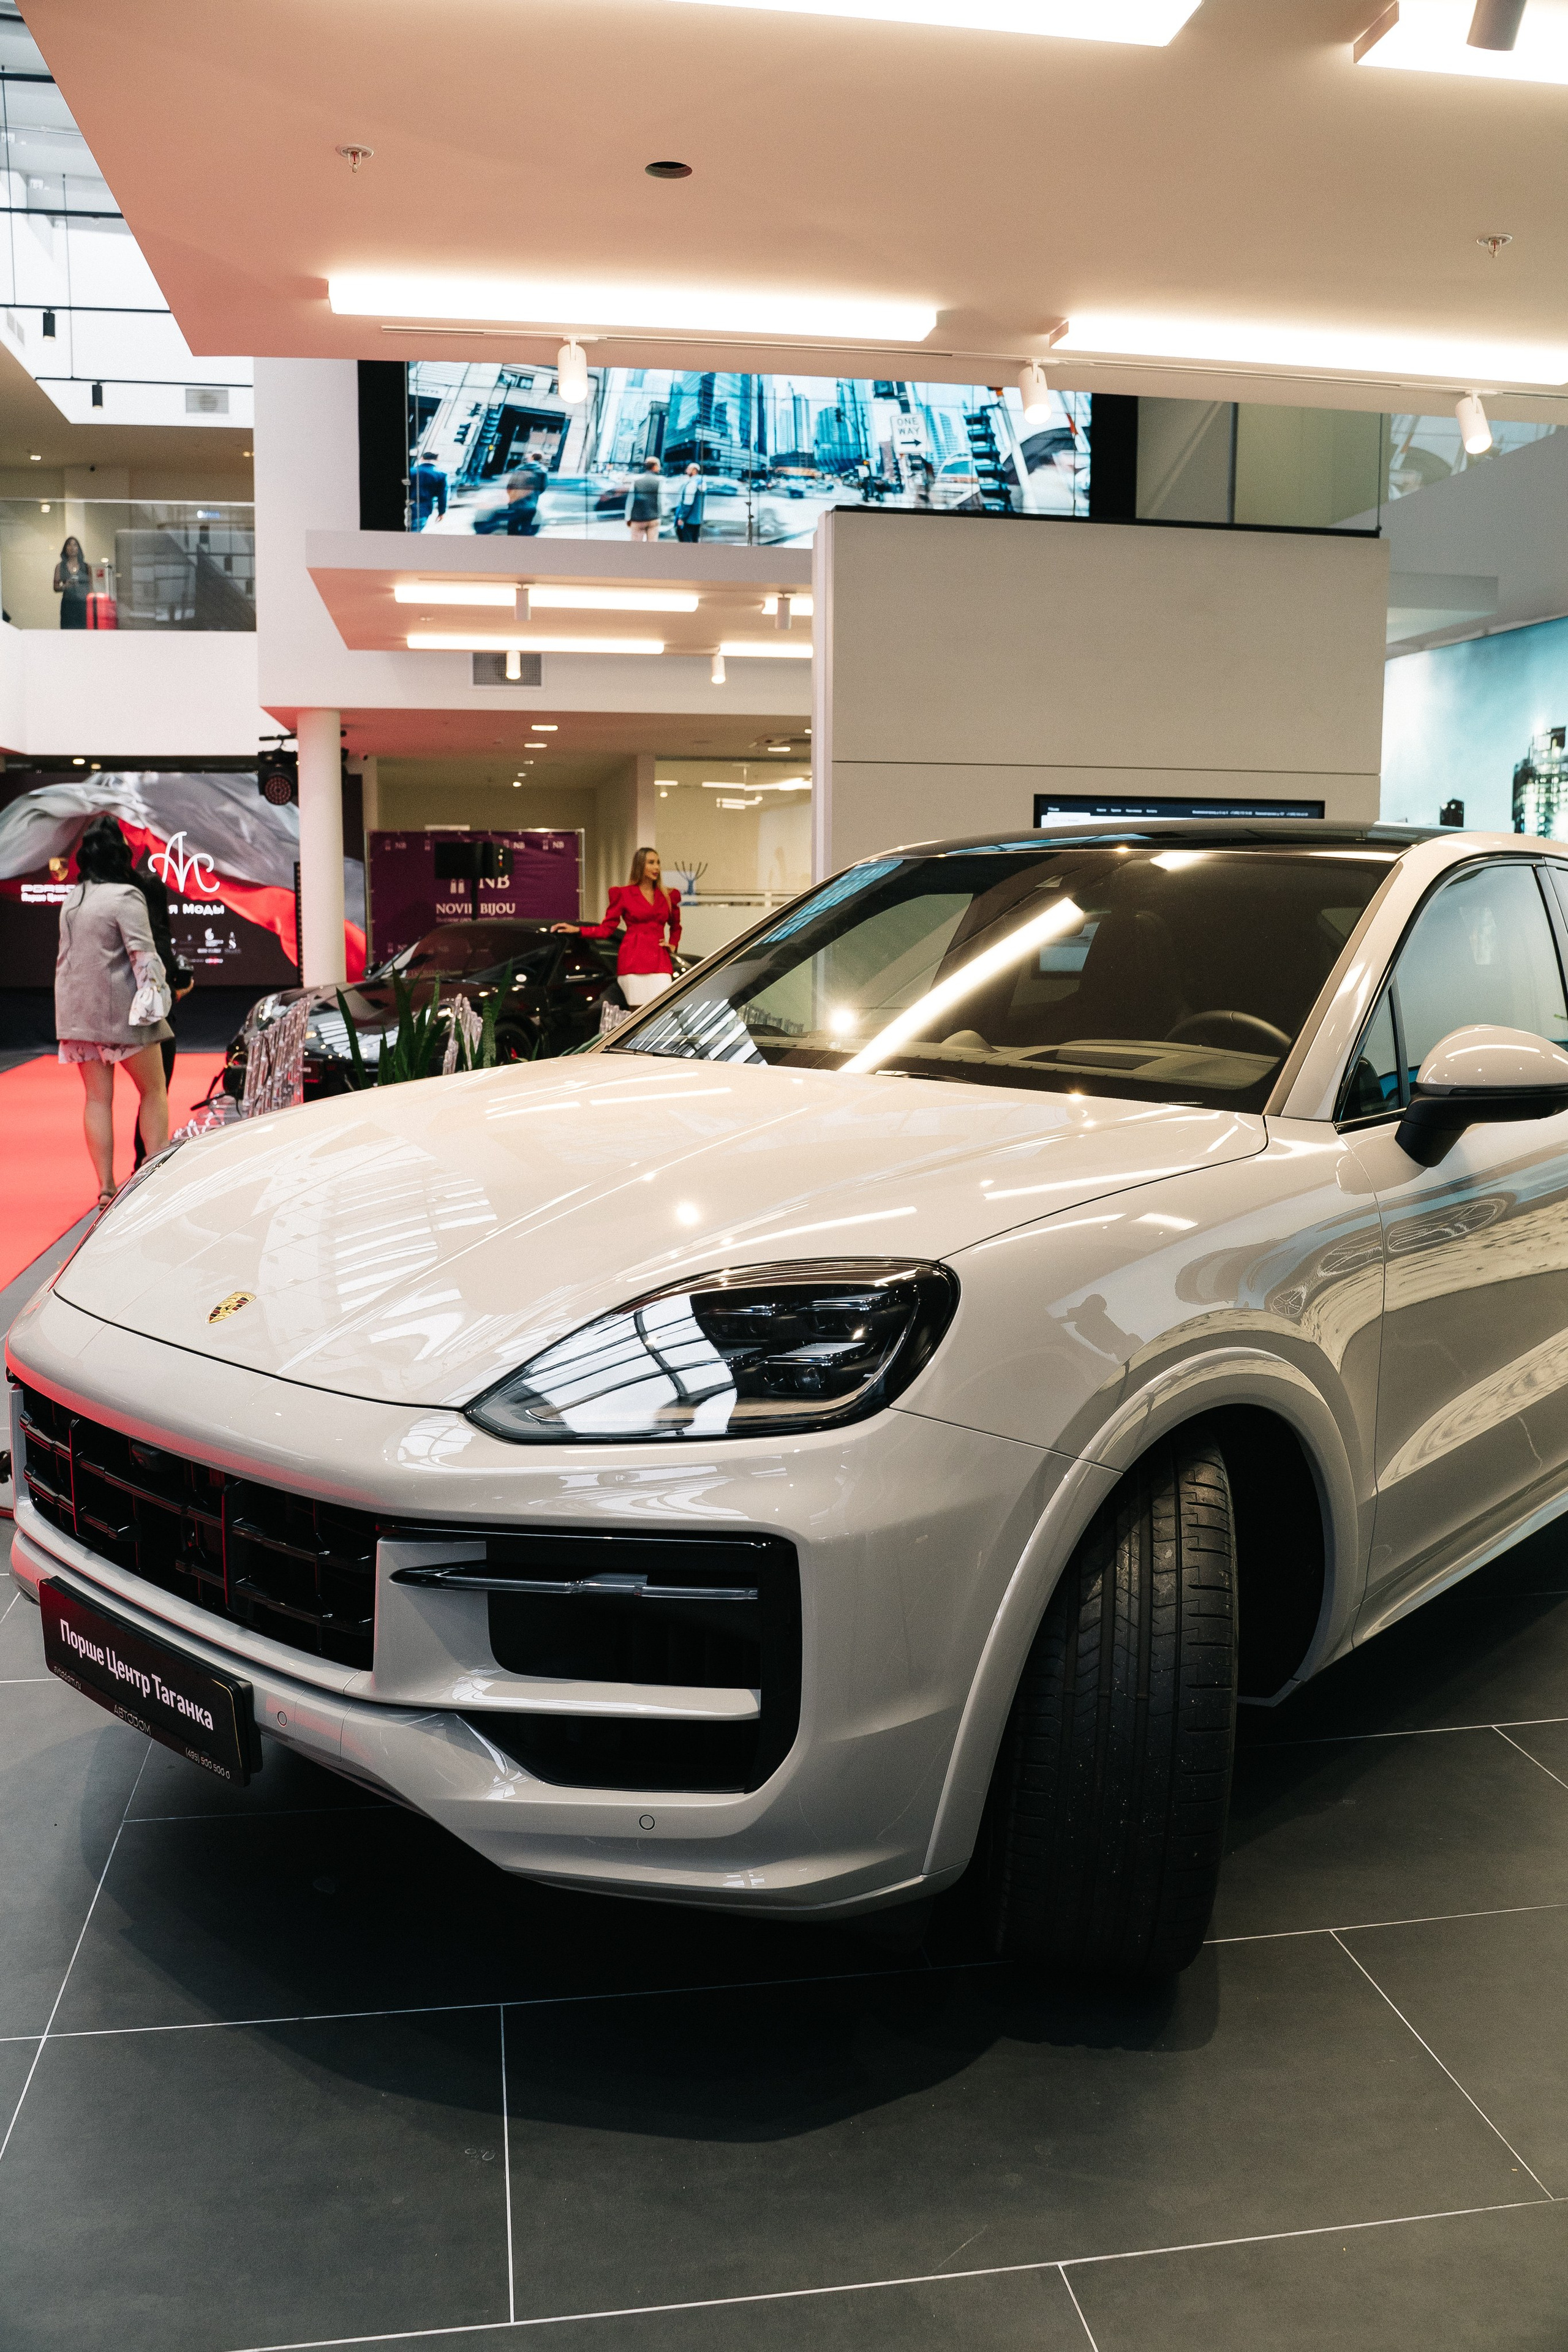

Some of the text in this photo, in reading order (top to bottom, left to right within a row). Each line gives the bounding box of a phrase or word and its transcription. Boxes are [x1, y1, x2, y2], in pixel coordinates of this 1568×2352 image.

[897, 417, 919, 426] ONE
[21, 884, 76, 893] PORSC
[183, 903, 225, 915] Моды
[480, 903, 516, 916] BIJOU
[53, 1666, 81, 1691] avtodom.ru
[60, 1618, 214, 1731] Порше Центр Таганка
[185, 1747, 230, 1779] (495) 500 500 0
